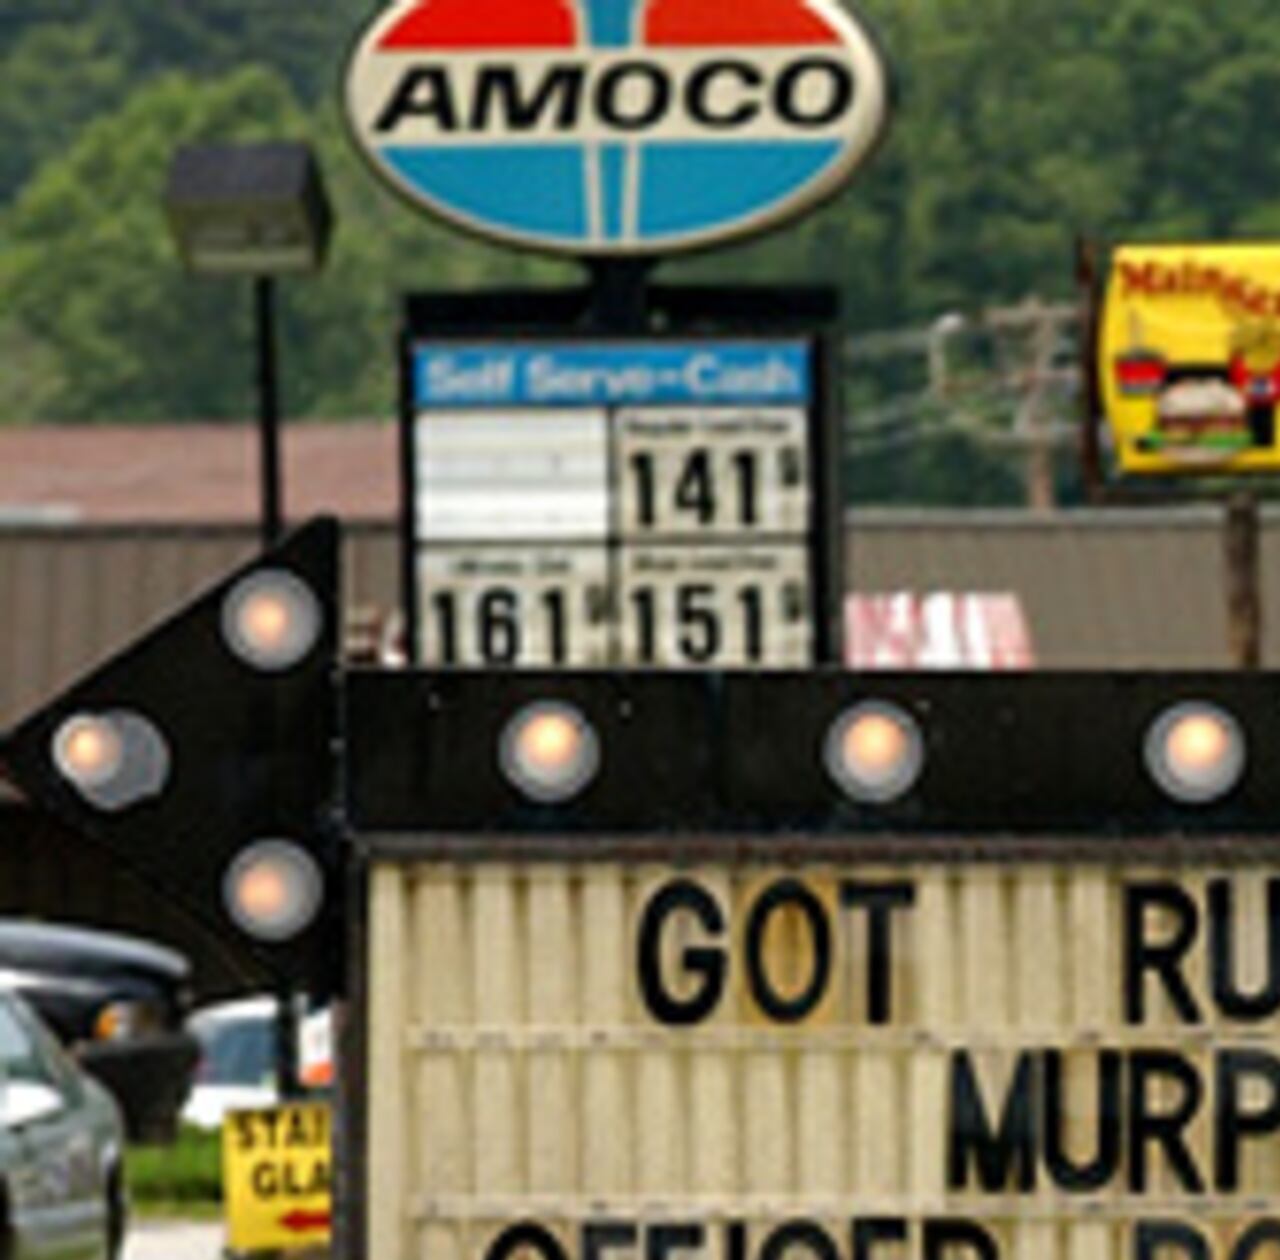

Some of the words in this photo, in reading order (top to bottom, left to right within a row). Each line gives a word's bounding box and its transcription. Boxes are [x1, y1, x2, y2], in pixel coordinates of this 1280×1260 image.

[373, 58, 854, 132] AMOCO
[426, 353, 515, 394] Self
[631, 447, 759, 528] 141
[432, 586, 566, 666] 161
[631, 584, 762, 664] 151
[637, 879, 916, 1024] GOT
